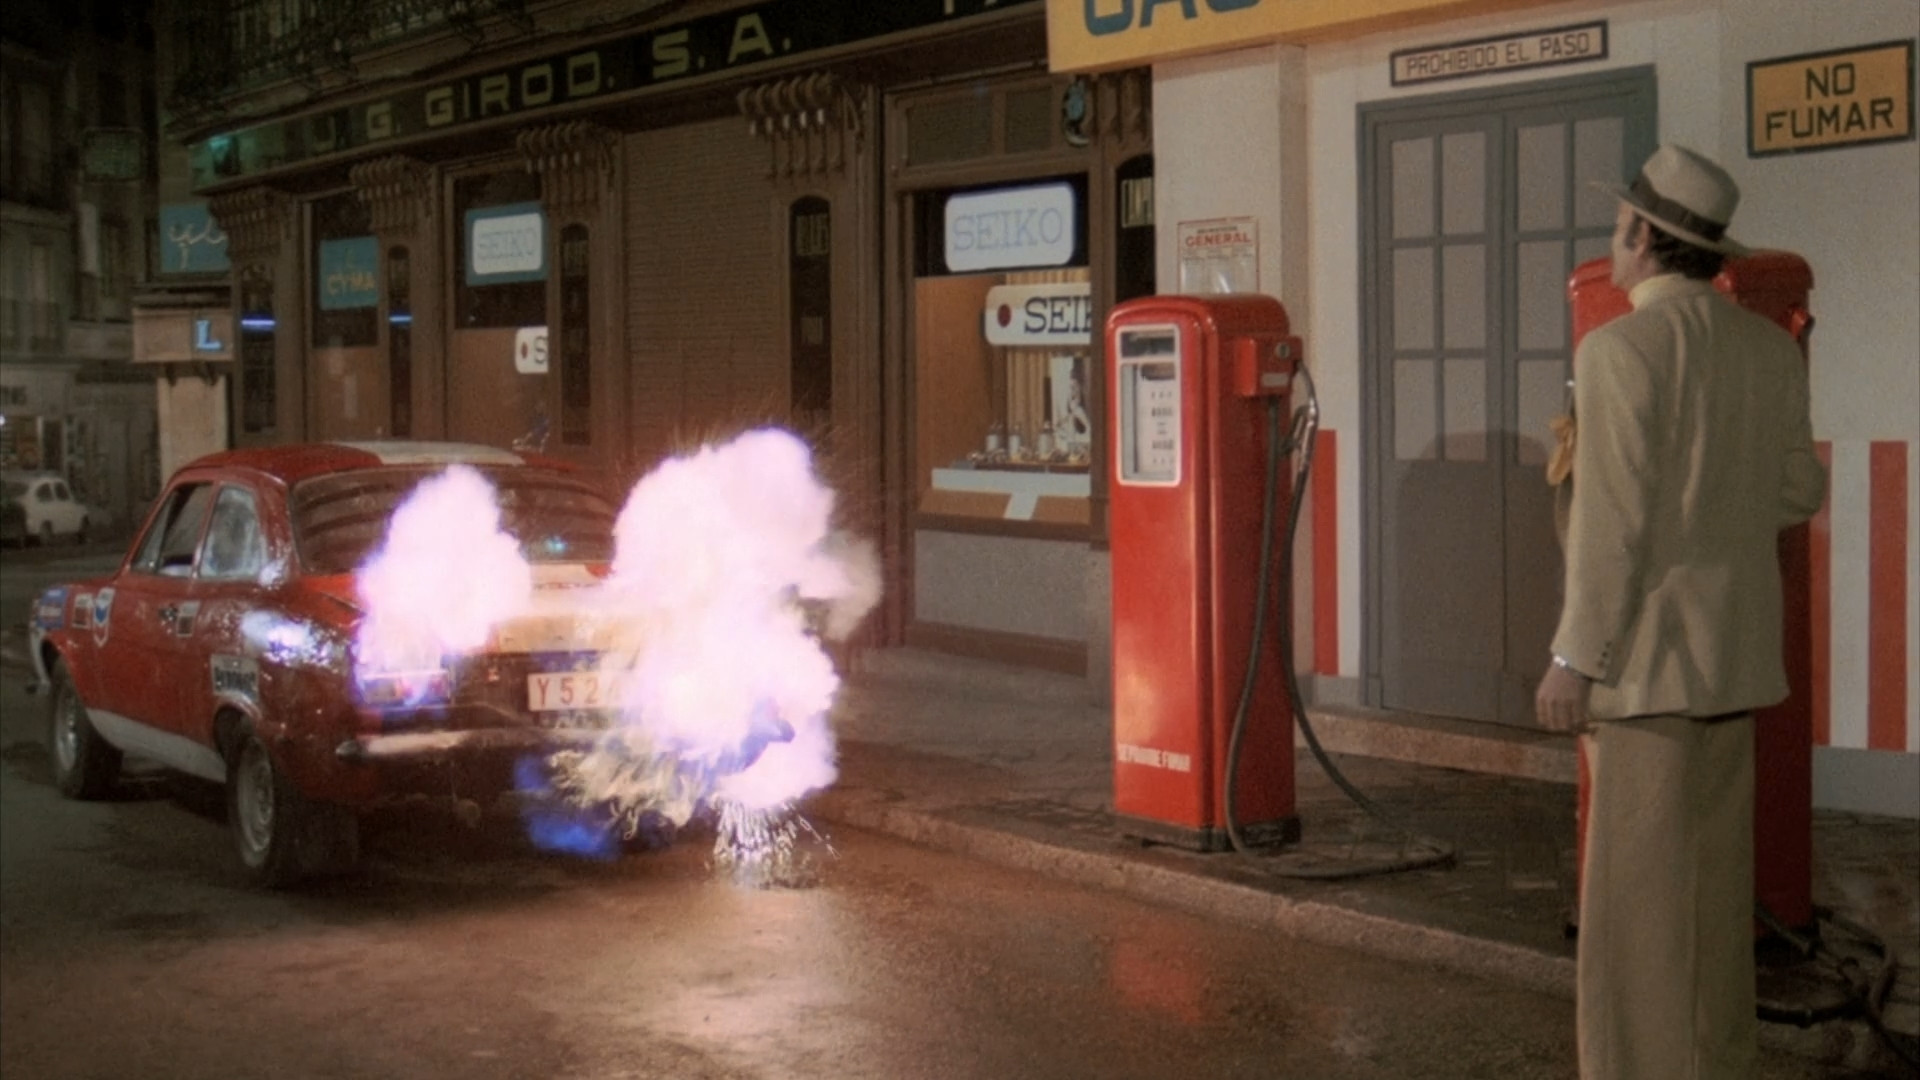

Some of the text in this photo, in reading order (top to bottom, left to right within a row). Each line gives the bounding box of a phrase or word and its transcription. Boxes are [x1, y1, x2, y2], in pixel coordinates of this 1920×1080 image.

[1406, 32, 1591, 77] PROHIBIDO EL PASO
[1806, 62, 1855, 100] NO
[1766, 97, 1894, 142] FUMAR
[477, 227, 538, 260] SEIKO
[953, 208, 1063, 250] SEIKO
[1185, 232, 1251, 247] GENERAL
